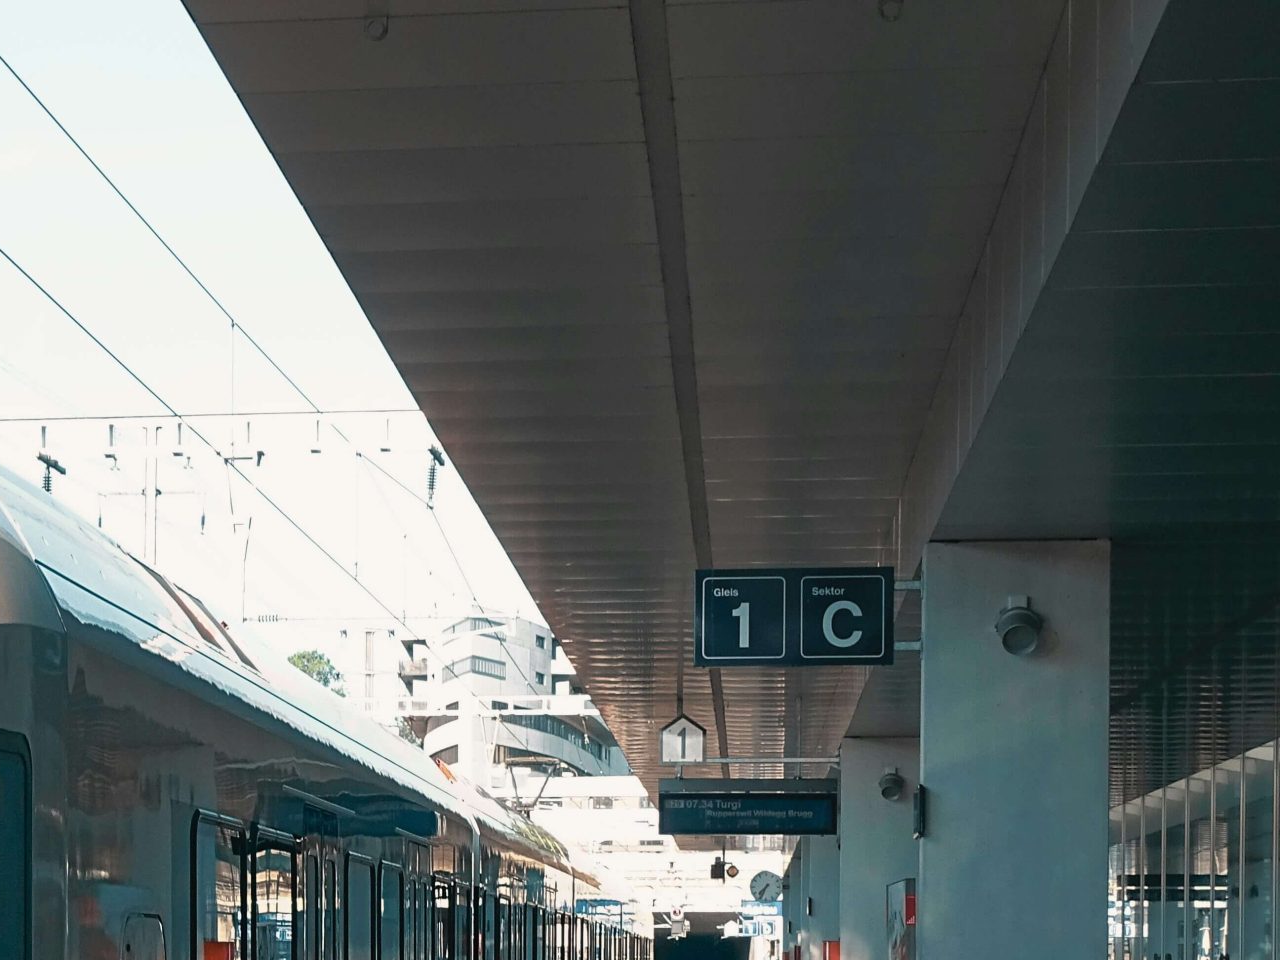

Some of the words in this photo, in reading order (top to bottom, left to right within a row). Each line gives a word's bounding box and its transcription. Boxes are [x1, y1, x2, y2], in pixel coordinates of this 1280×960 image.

[714, 588, 739, 597] Gleis
[812, 586, 846, 596] Sektor
[732, 602, 750, 648] 1
[822, 600, 863, 648] C
[677, 727, 686, 759] 1
[716, 800, 742, 810] Turgi
